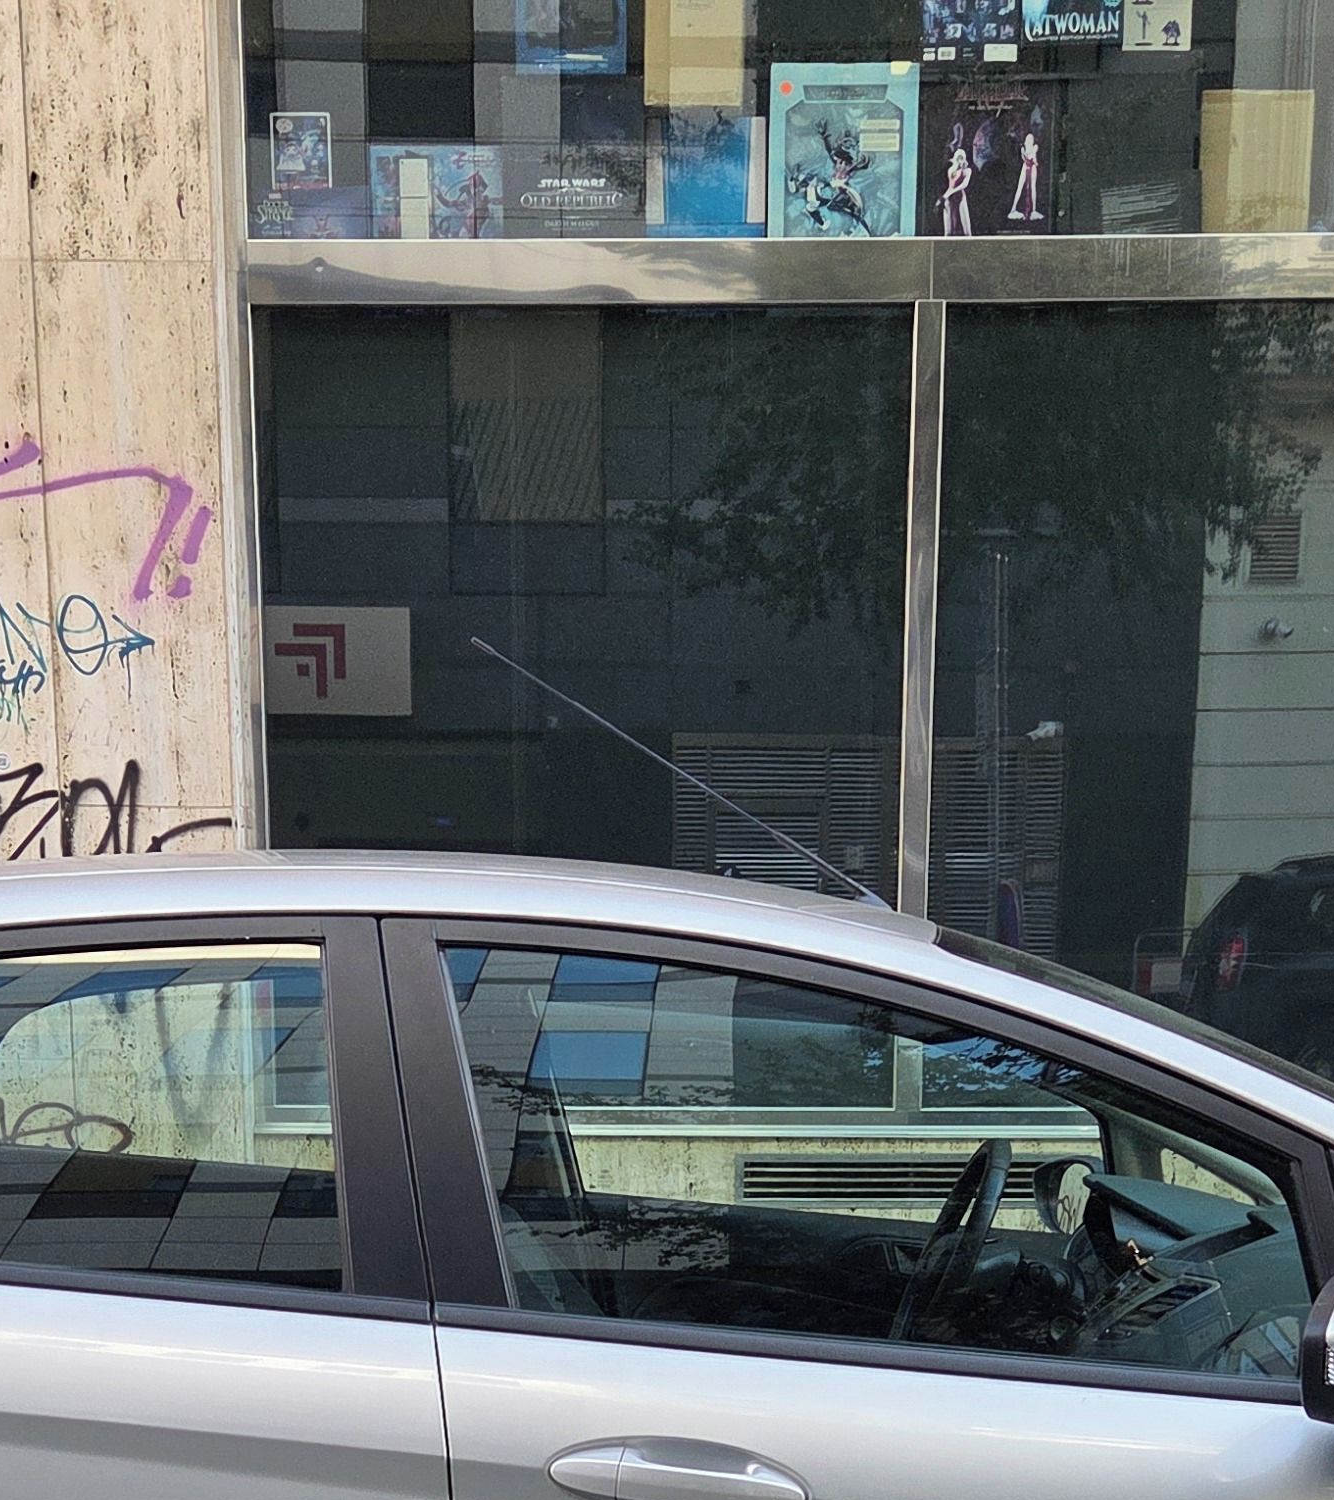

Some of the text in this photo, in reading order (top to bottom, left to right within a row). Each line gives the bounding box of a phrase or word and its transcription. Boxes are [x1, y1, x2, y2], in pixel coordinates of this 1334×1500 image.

[1024, 11, 1120, 41] CATWOMAN
[538, 178, 606, 188] STAR WARS
